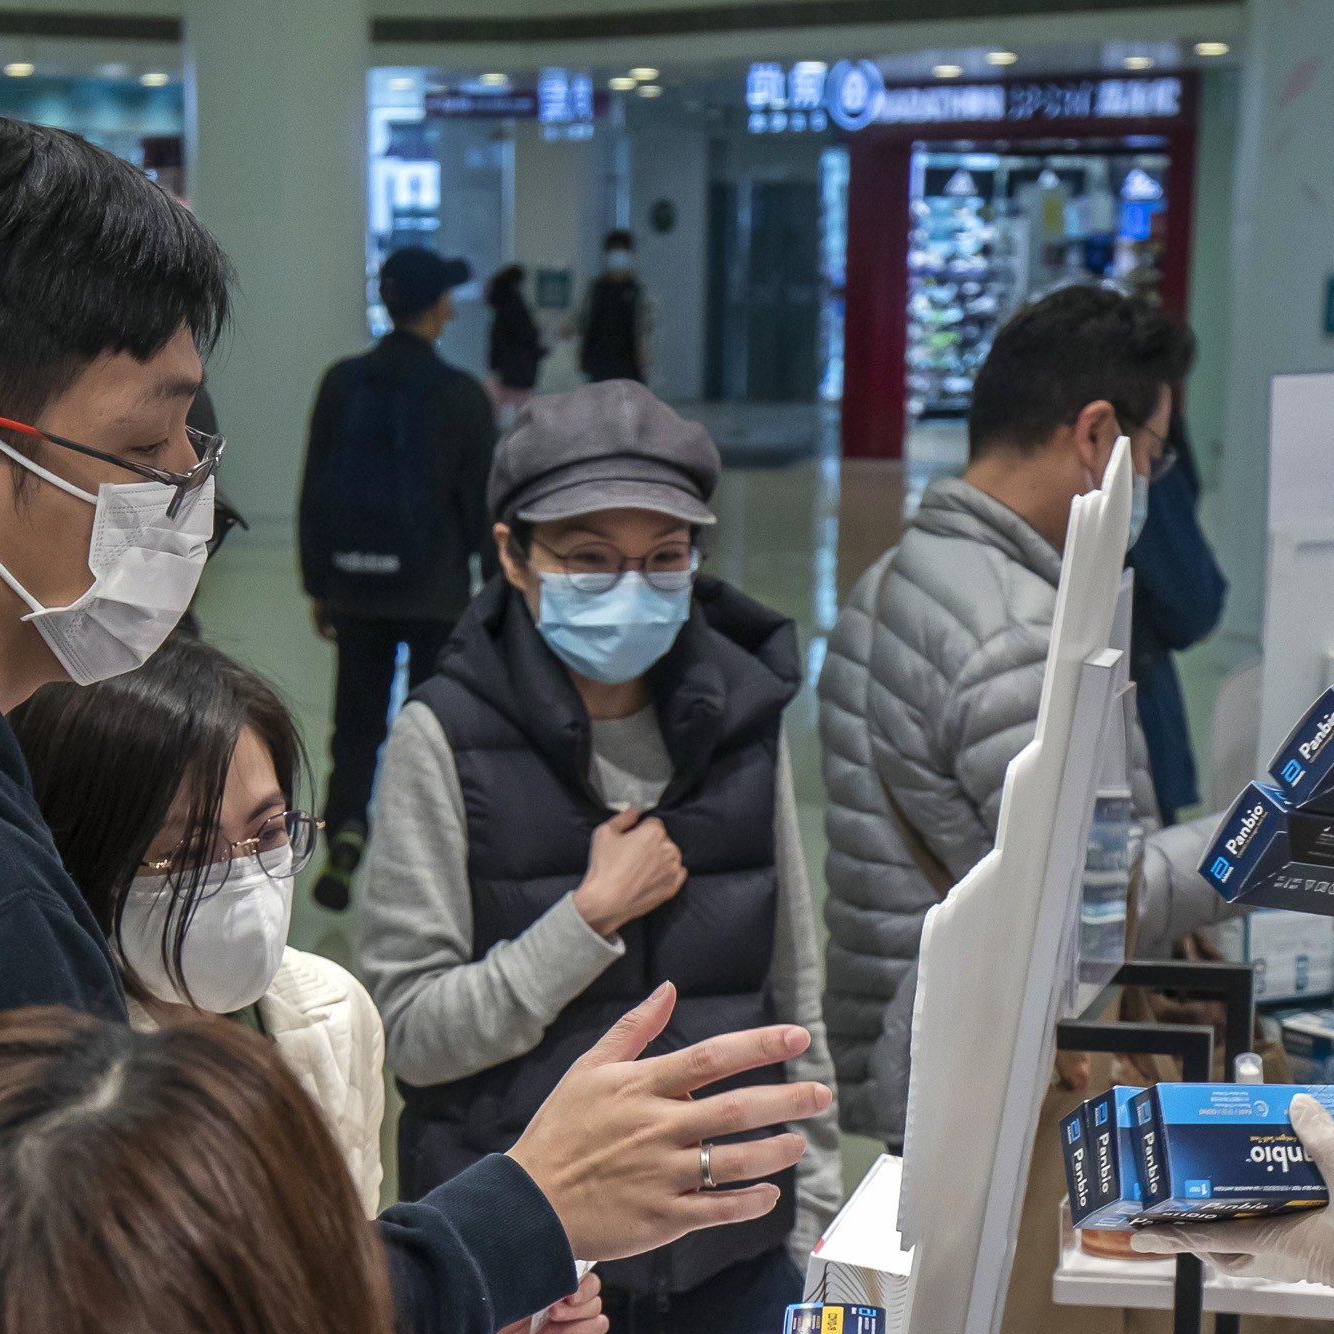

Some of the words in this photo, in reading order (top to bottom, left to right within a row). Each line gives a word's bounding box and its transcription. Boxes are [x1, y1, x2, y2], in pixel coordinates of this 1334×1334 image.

[1225, 804, 1264, 856] Panbio
[1073, 1148, 1089, 1208] Panbio
[1099, 1132, 1110, 1194] Panbio
[1143, 1132, 1157, 1194] Panbio
[1249, 1146, 1312, 1173] nbio
[1201, 1202, 1268, 1211] Panbio
